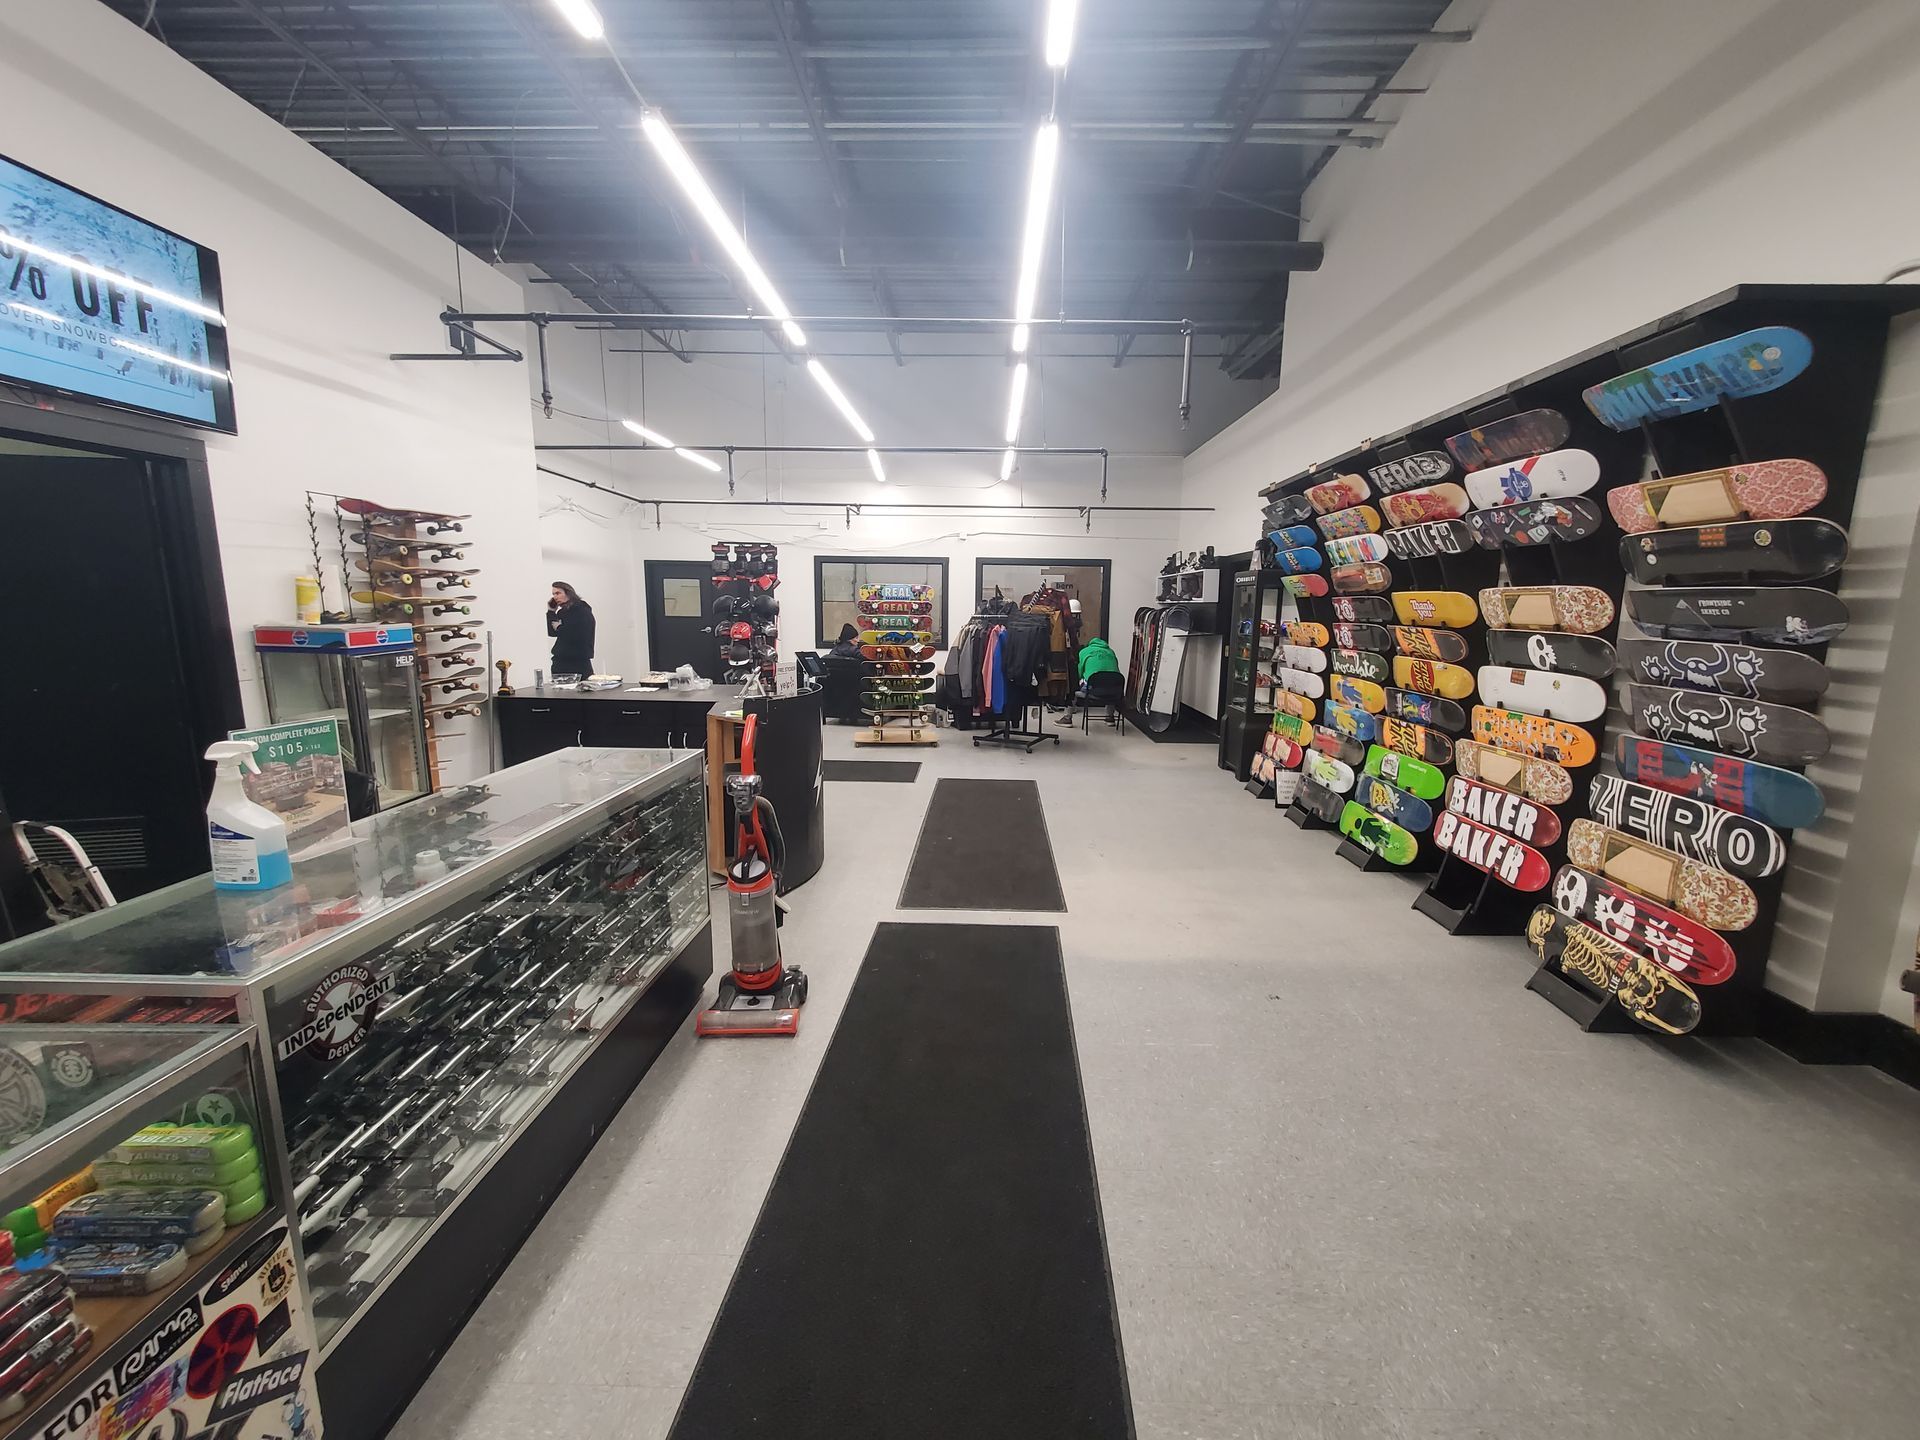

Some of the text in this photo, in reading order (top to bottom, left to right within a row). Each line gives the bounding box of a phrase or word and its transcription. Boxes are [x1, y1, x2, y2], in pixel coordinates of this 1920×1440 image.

[70, 253, 153, 333] OFF
[1385, 522, 1461, 559] BAKER
[885, 588, 910, 597] REAL
[1409, 599, 1436, 611] Thank
[1417, 610, 1433, 621] you
[396, 656, 414, 665] HELP
[1333, 651, 1376, 679] hocolate
[269, 742, 303, 758] $105
[270, 729, 303, 742] COMPLETE
[304, 724, 331, 736] PACKAGE
[1449, 778, 1538, 841] BAKER
[1589, 774, 1782, 877] ZERO
[1436, 812, 1525, 884] BAKER
[1616, 953, 1633, 977] ZERO
[306, 966, 369, 1013] AUTHORIZED
[284, 976, 391, 1055] INDEPENDENT
[327, 1028, 367, 1060] DEALER
[221, 1363, 302, 1409] FlatFace
[44, 1378, 115, 1440] FOR
